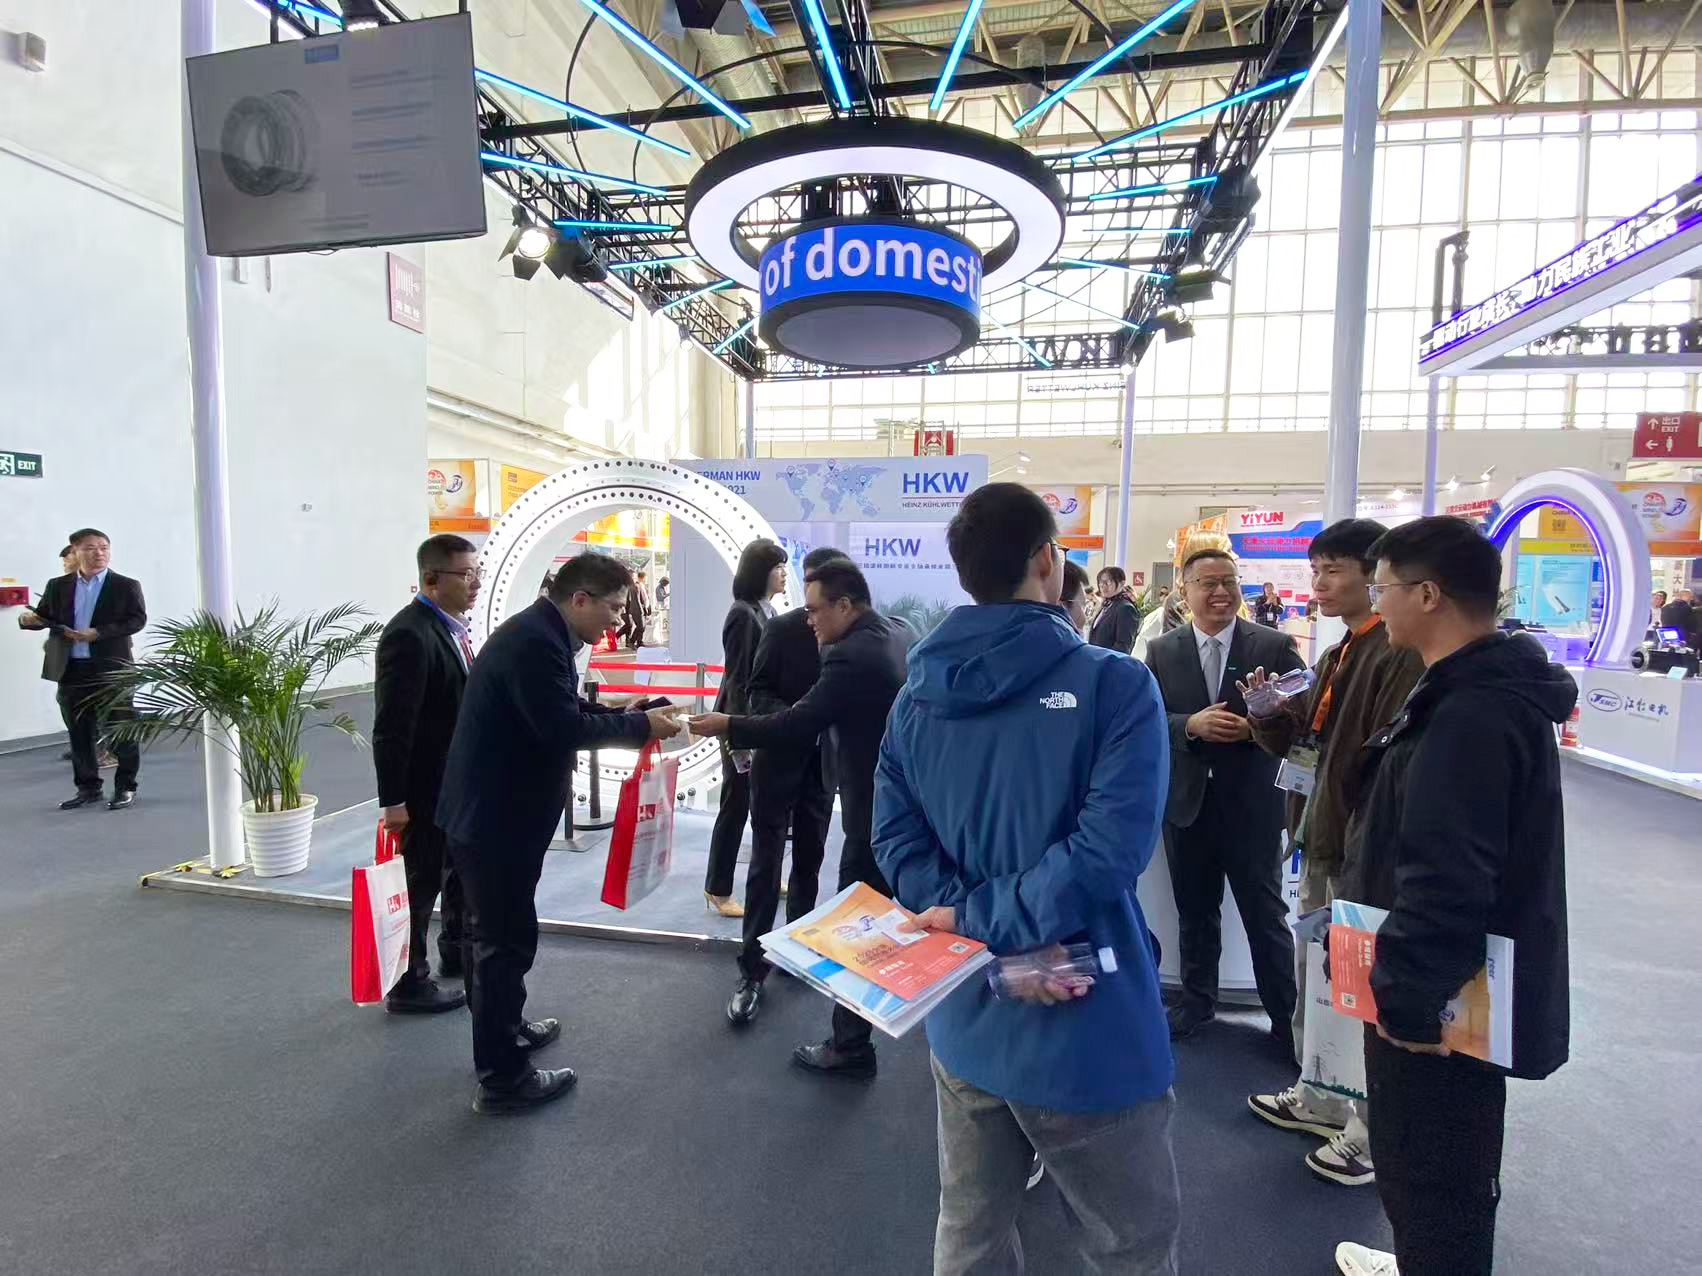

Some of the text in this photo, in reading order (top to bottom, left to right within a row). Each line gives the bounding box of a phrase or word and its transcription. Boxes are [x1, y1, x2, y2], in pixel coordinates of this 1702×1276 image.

[764, 235, 797, 296] of
[1661, 416, 1680, 425] 出口
[17, 460, 37, 471] EXIT
[694, 471, 760, 481] RMAN HKW
[903, 472, 969, 493] HKW
[724, 485, 746, 495] 921
[865, 538, 921, 557] HKW
